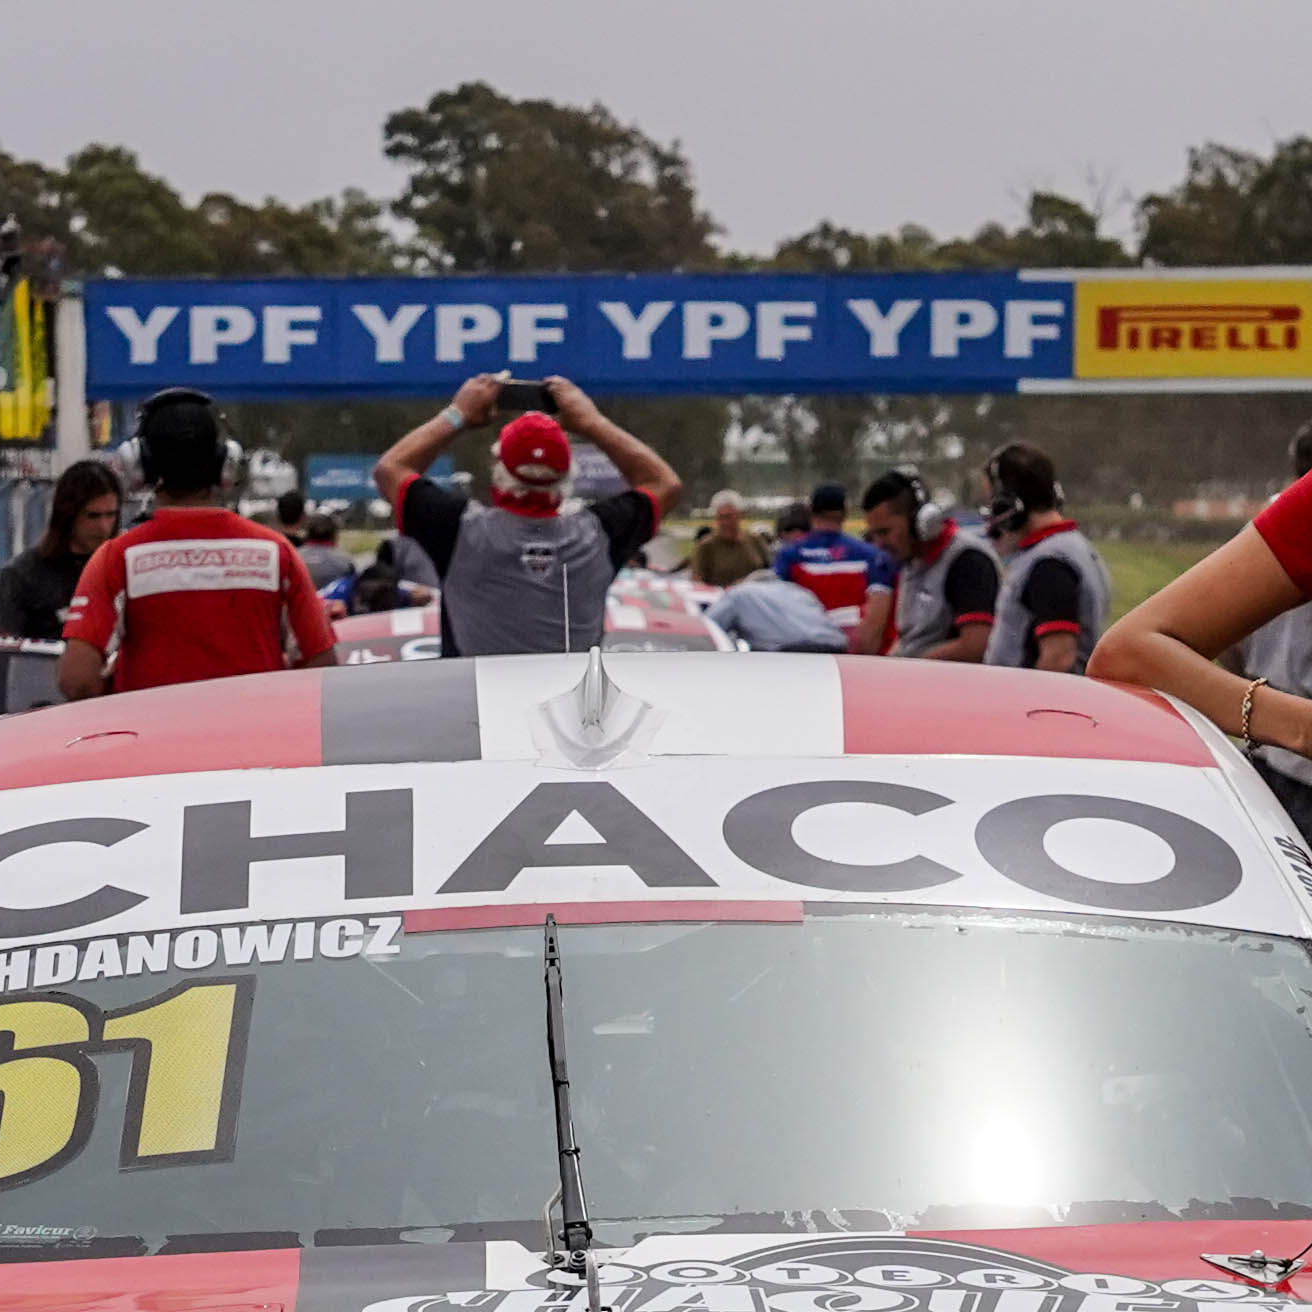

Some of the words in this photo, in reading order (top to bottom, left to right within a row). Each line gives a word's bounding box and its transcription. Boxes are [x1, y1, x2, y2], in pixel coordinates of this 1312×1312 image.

[104, 304, 323, 365] YPF
[351, 303, 569, 363] YPF
[599, 300, 819, 361] YPF
[846, 299, 1068, 359] YPF
[1095, 304, 1303, 352] PIRELLI
[2, 1223, 74, 1238] Favicur
[568, 1260, 1248, 1297] OTERIA
